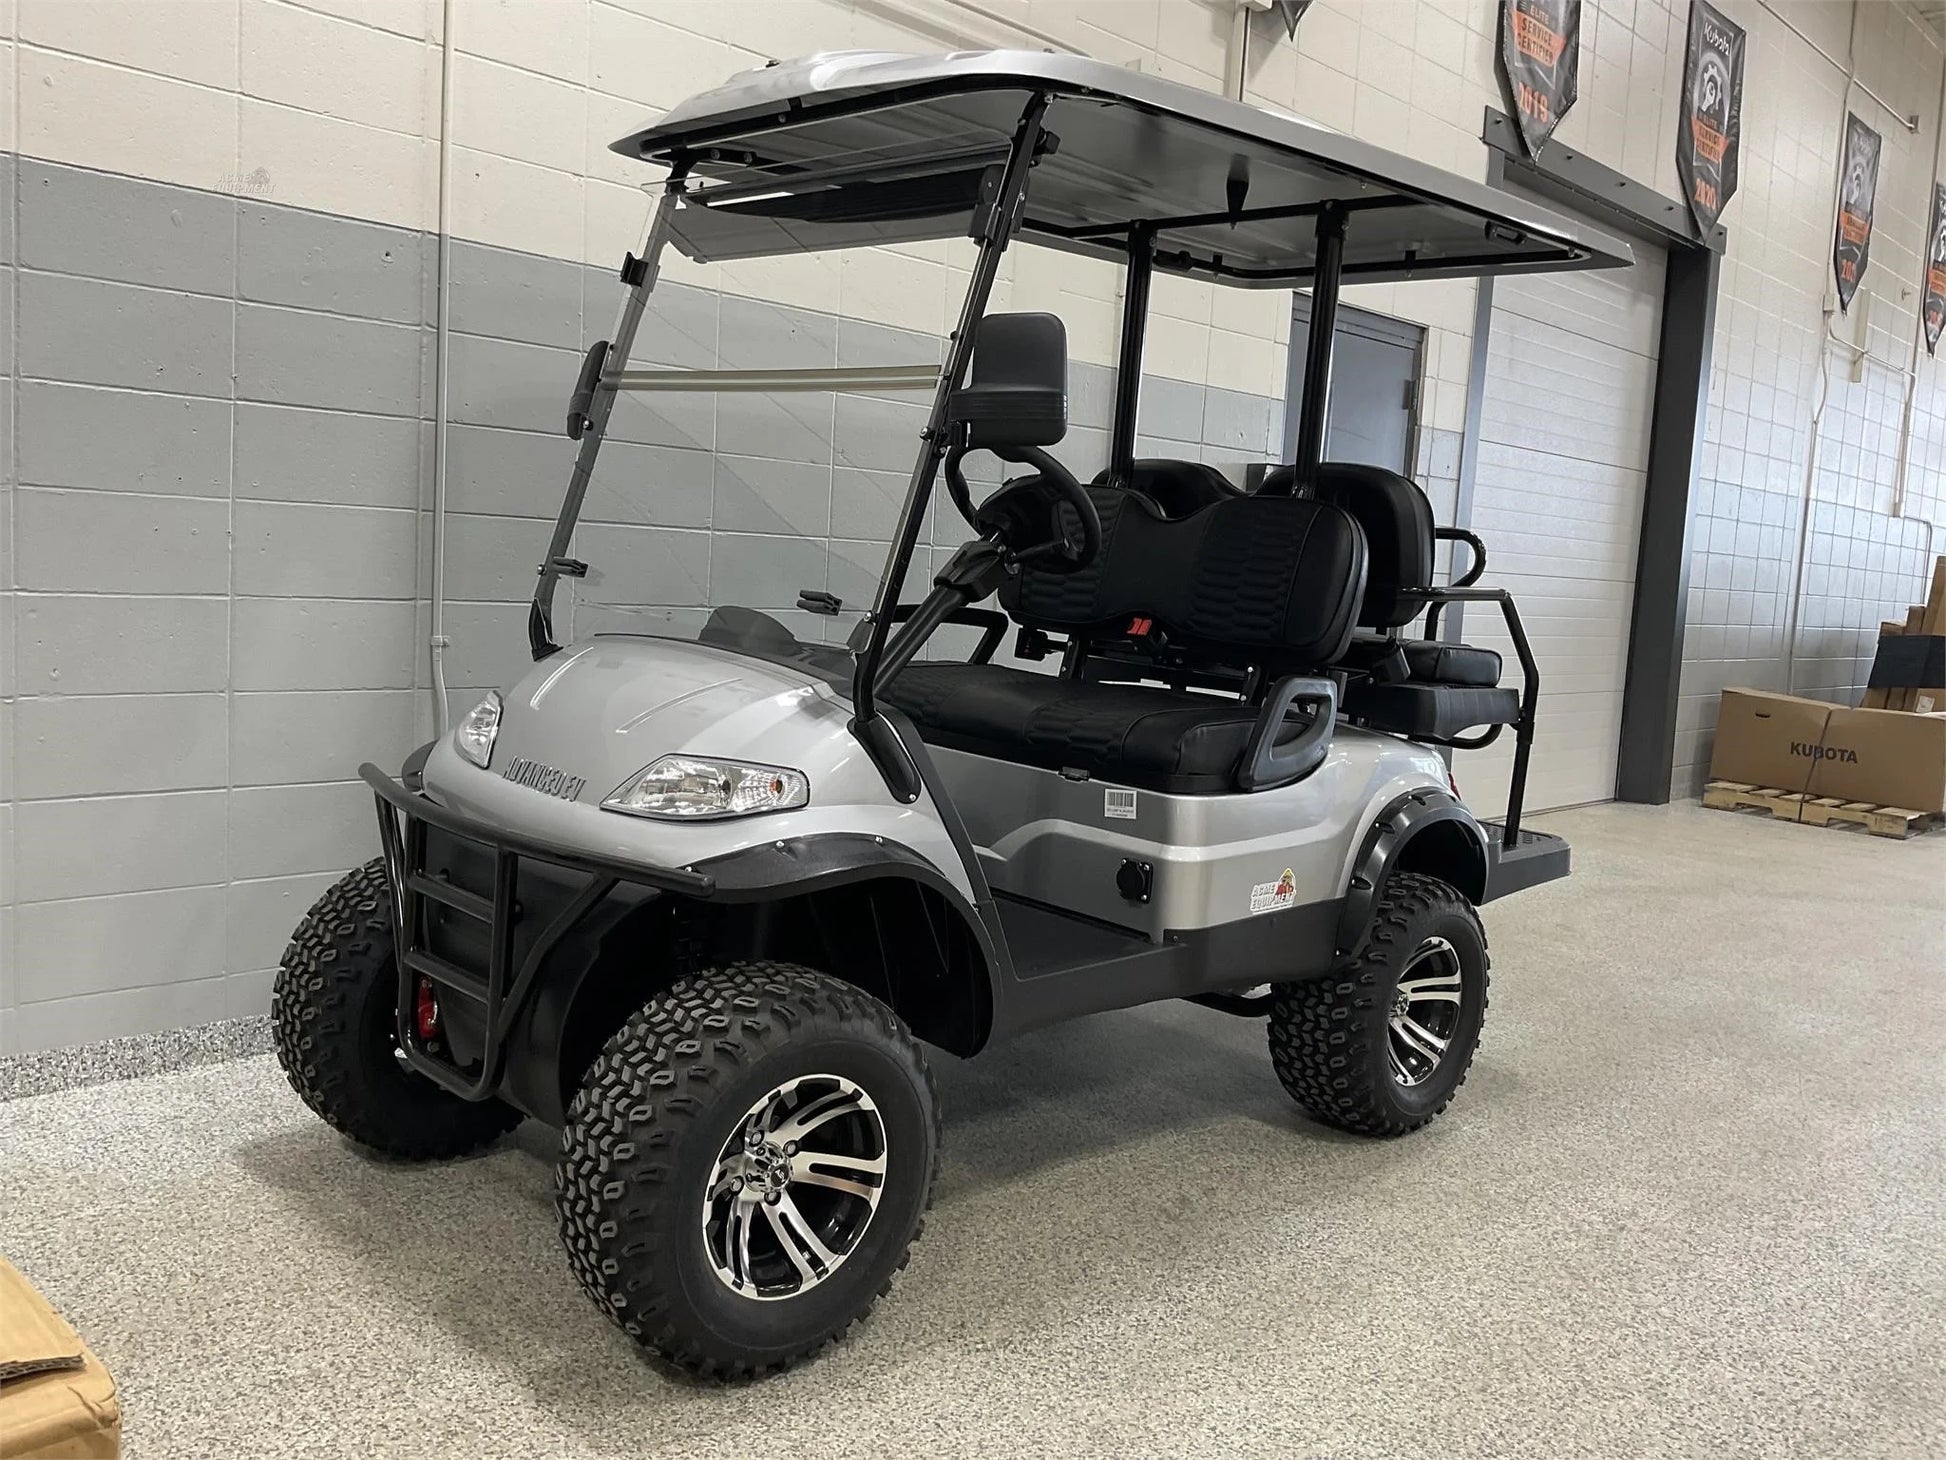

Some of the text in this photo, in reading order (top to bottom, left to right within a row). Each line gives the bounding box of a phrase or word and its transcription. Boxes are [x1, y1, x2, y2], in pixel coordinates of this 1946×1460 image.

[1521, 17, 1552, 47] SERVICE
[1703, 22, 1731, 57] Kubota
[1790, 741, 1858, 764] KUBOTA
